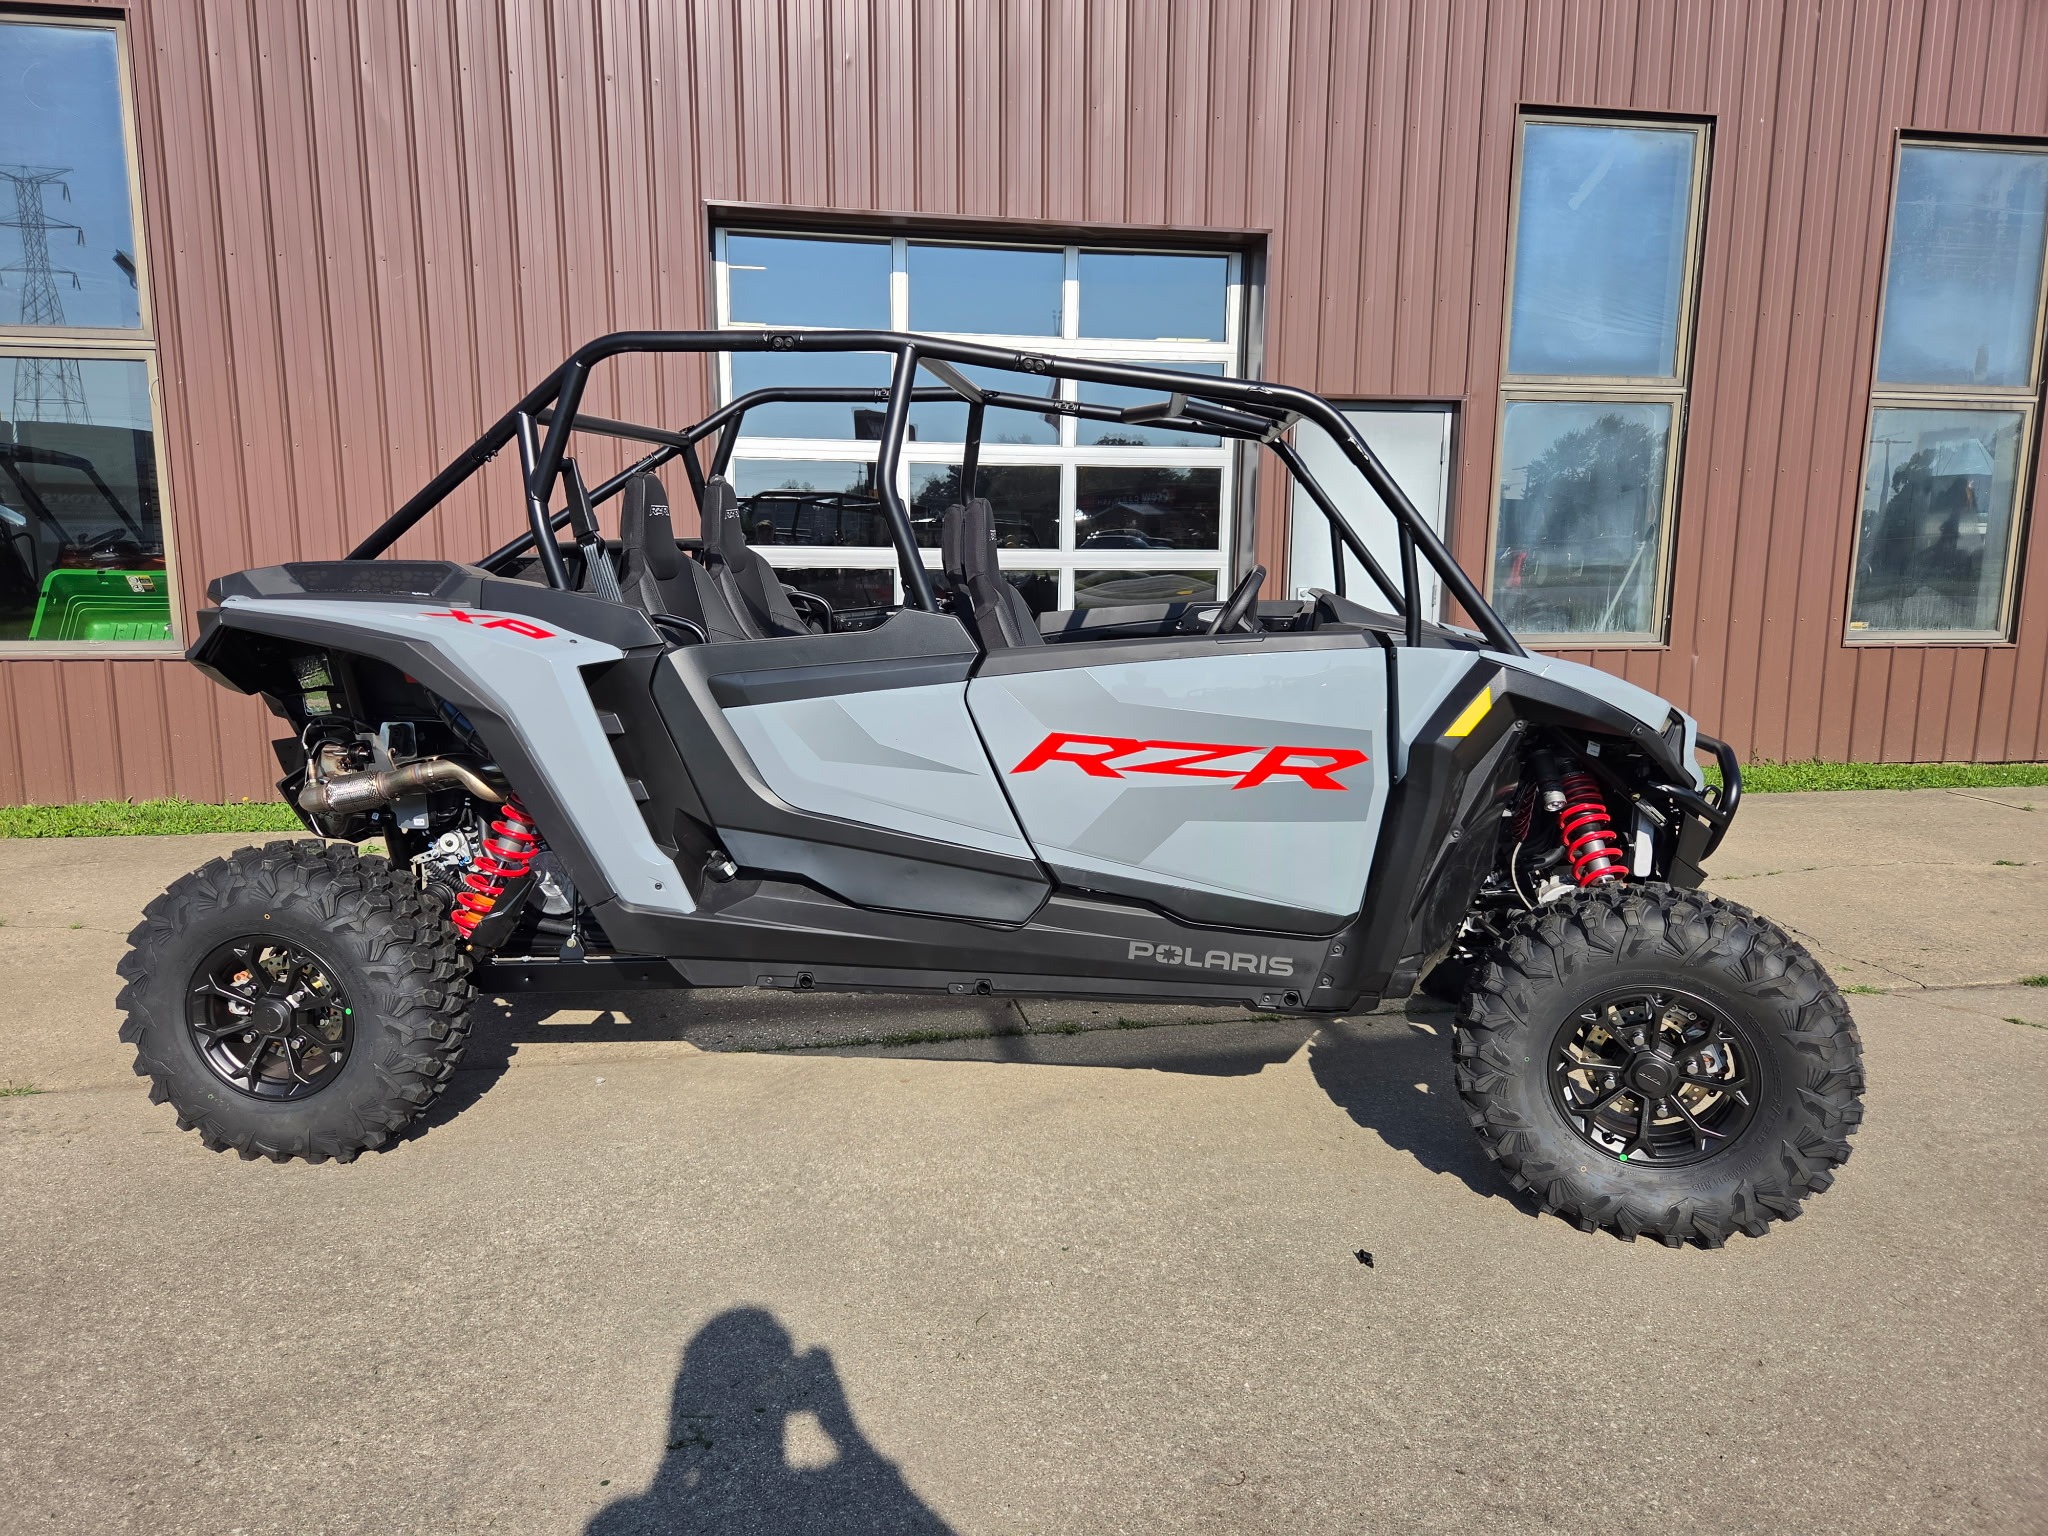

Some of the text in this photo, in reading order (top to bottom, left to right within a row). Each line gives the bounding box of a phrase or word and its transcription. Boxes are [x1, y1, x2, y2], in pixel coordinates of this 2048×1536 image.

[417, 609, 558, 640] XP
[1009, 732, 1370, 791] RZR
[1127, 940, 1294, 977] POLARIS
